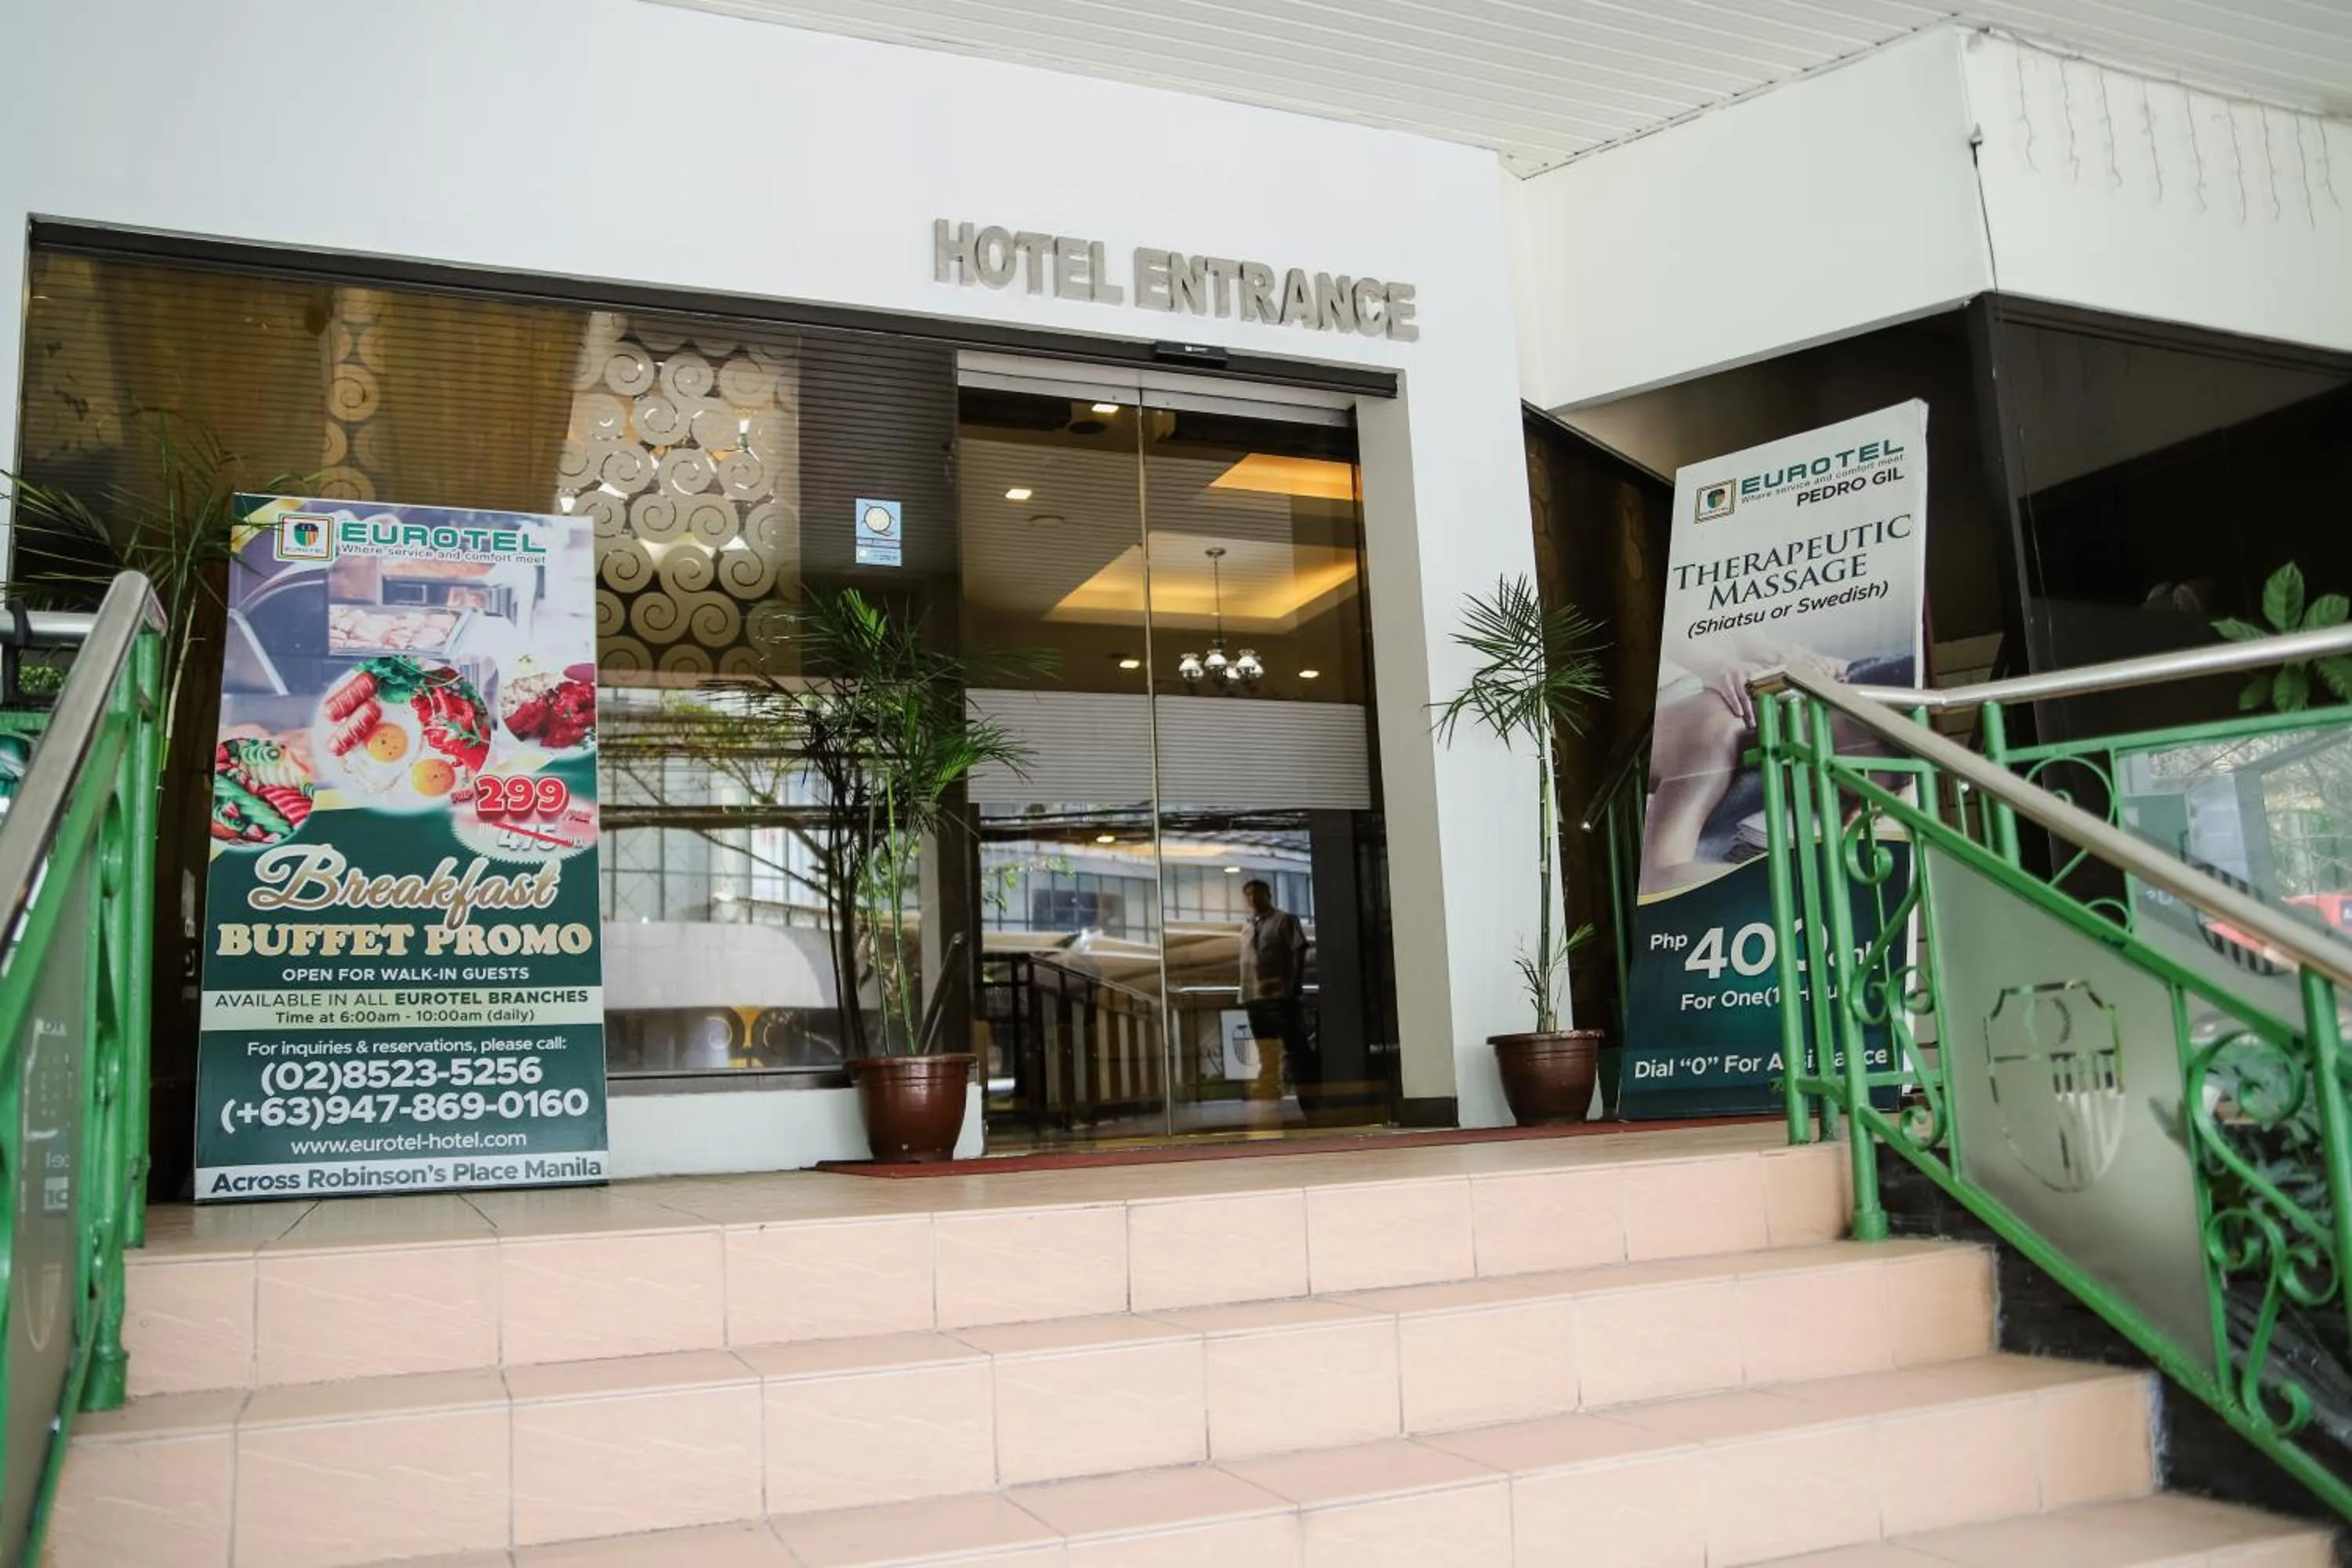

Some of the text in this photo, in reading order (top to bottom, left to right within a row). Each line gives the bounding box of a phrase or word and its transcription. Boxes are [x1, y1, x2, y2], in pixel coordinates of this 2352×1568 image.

[934, 218, 1420, 343] HOTEL ENTRANCE
[1740, 439, 1905, 495] EUROTEL
[1776, 481, 1811, 495] service
[1813, 473, 1833, 488] and
[1835, 463, 1875, 479] comfort
[1797, 467, 1905, 507] PEDRO GIL
[339, 521, 547, 554] EUROTEL
[340, 543, 546, 564] Where service and comfort meet
[1673, 514, 1911, 590] THERAPEUTIC
[1708, 552, 1867, 610] MASSAGE
[1688, 580, 1889, 639] (Shiatsu or Swedish)
[477, 775, 569, 819] 299
[498, 823, 557, 851] 475
[247, 844, 562, 930] Breakfast
[216, 923, 592, 956] BUFFET PROMO
[1650, 933, 1688, 951] Php
[282, 967, 530, 982] OPEN FOR WALK-IN GUESTS
[215, 989, 590, 1008] AVAILABLE IN ALL EUROTEL BRANCHES
[1681, 993, 1715, 1011] For
[276, 1011, 315, 1025] Time
[320, 1013, 335, 1024] at
[339, 1011, 401, 1024] 6:00am
[416, 1009, 483, 1023] 10:00am
[486, 1009, 535, 1024] (daily)
[248, 1036, 568, 1058] For inquiries & reservations, please call:
[260, 1055, 543, 1097] (02)8523-5256
[1635, 1058, 1674, 1080] Dial
[1724, 1055, 1762, 1073] For
[220, 1087, 590, 1135] (+63)947-869-0160
[291, 1131, 528, 1155] www.eurotel-hotel.com
[211, 1157, 602, 1193] Across Robinson's Place Manila
